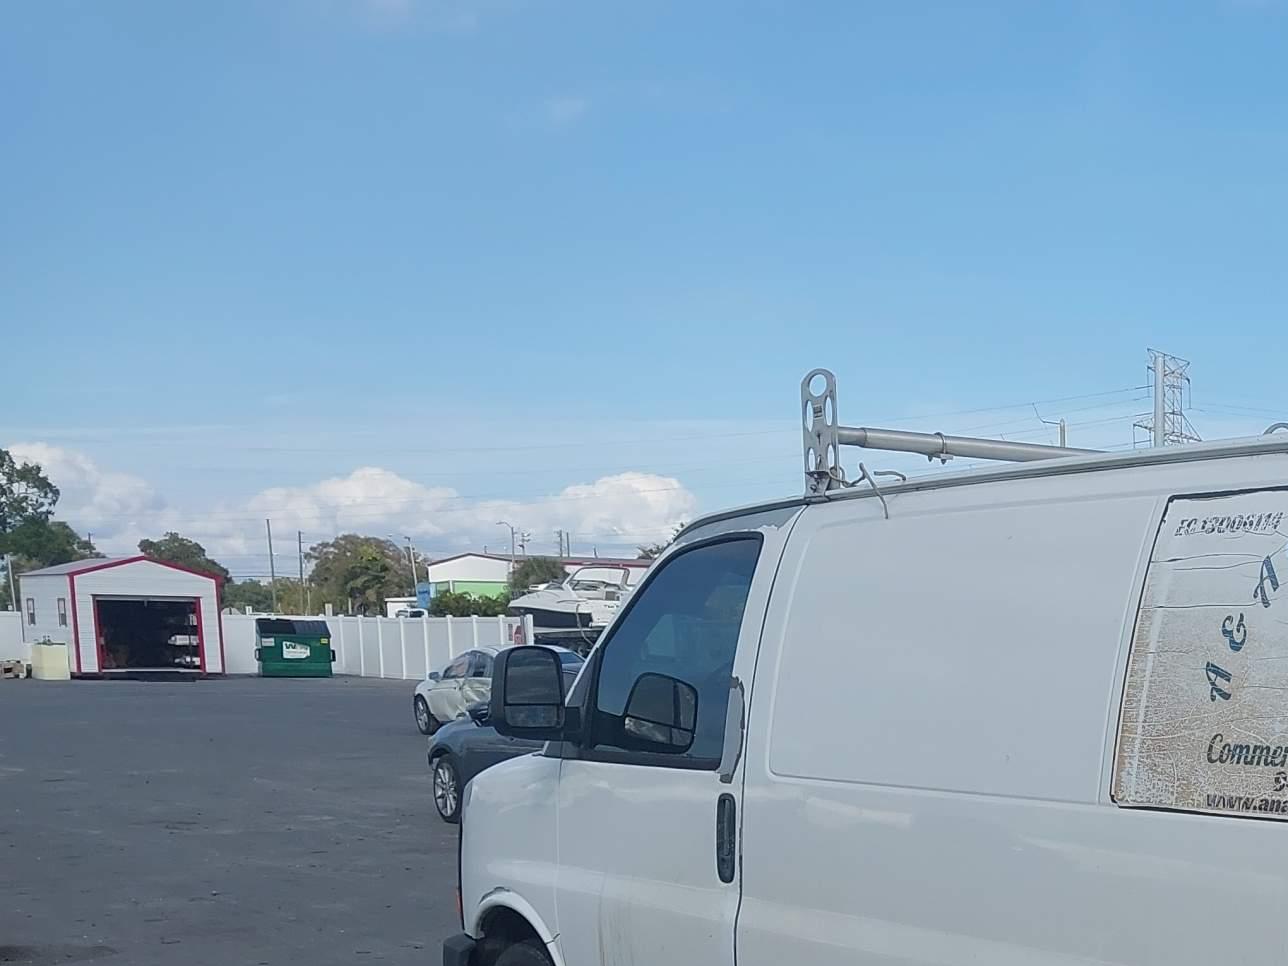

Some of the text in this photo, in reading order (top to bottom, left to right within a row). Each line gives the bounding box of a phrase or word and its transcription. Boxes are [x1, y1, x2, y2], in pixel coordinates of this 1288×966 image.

[1205, 661, 1233, 702] A
[1221, 613, 1247, 652] &
[1253, 555, 1280, 608] A
